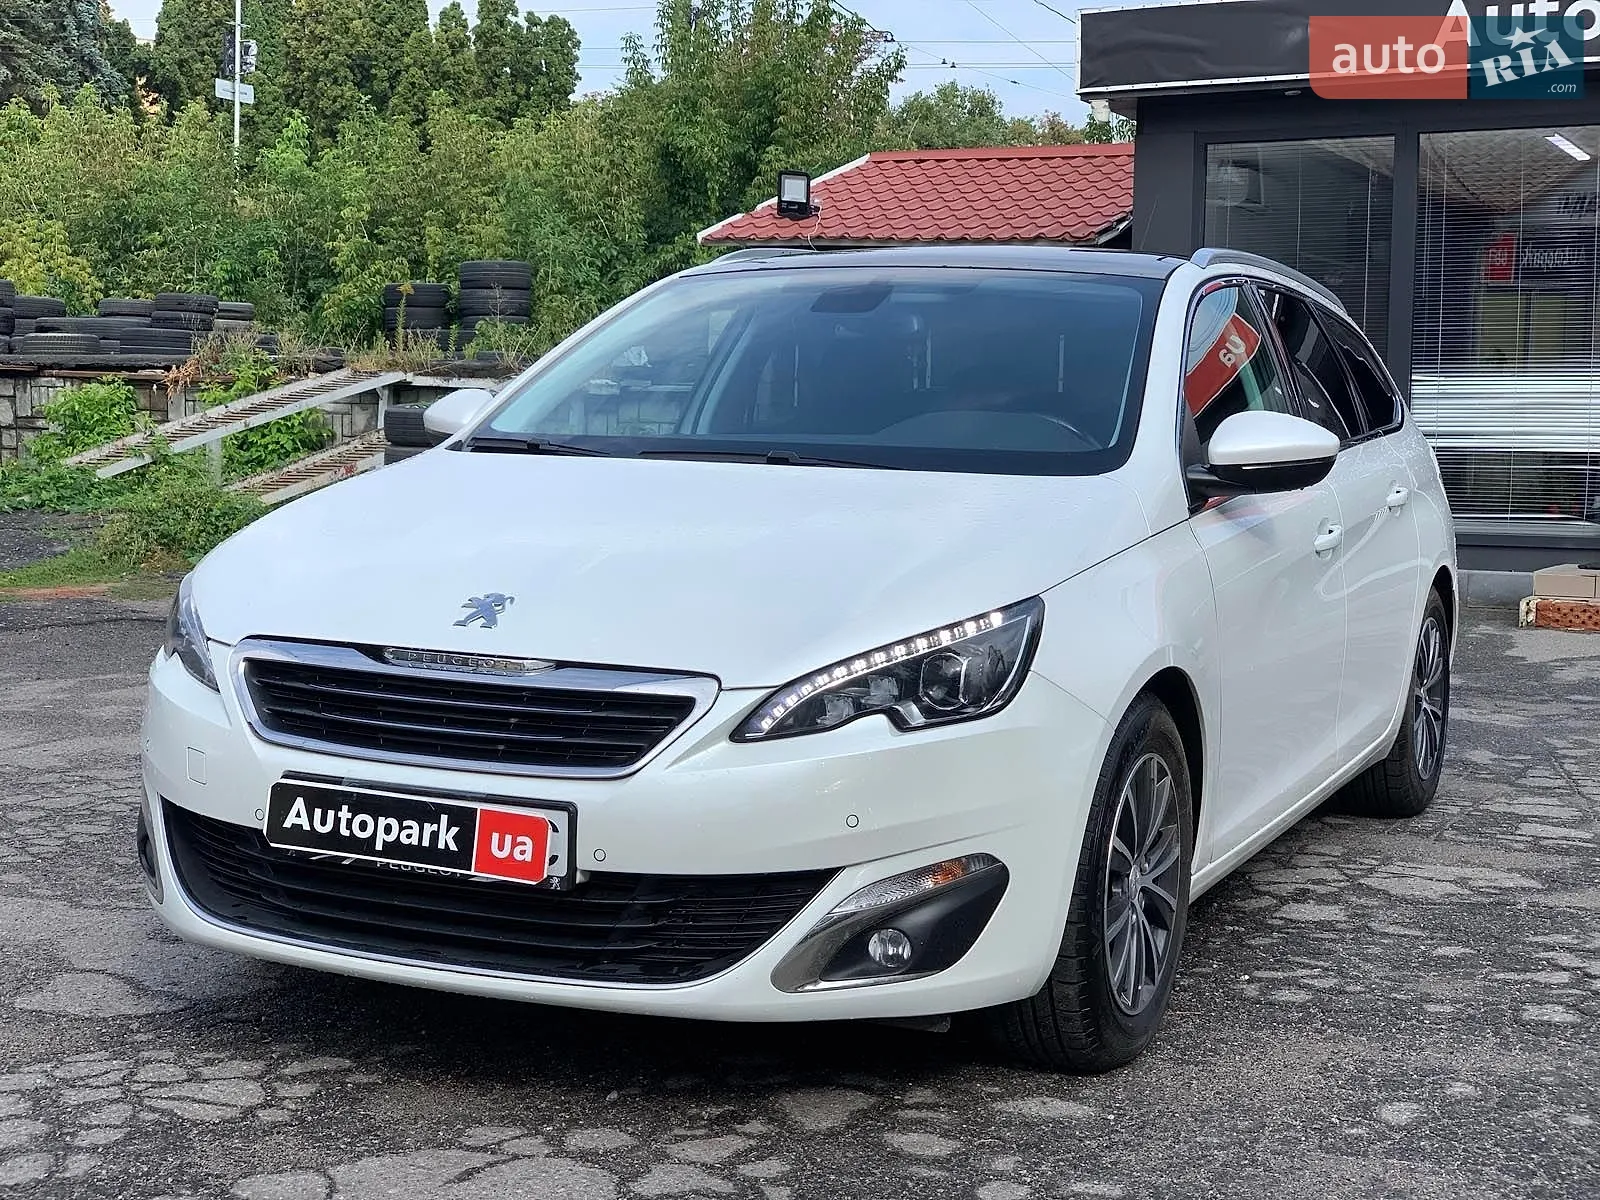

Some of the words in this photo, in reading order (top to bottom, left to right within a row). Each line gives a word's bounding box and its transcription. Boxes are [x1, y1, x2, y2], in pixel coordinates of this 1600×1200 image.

[1434, 0, 1600, 47] Auto
[407, 651, 509, 669] PEUGEOT
[282, 796, 461, 851] Autopark
[491, 831, 533, 862] ua
